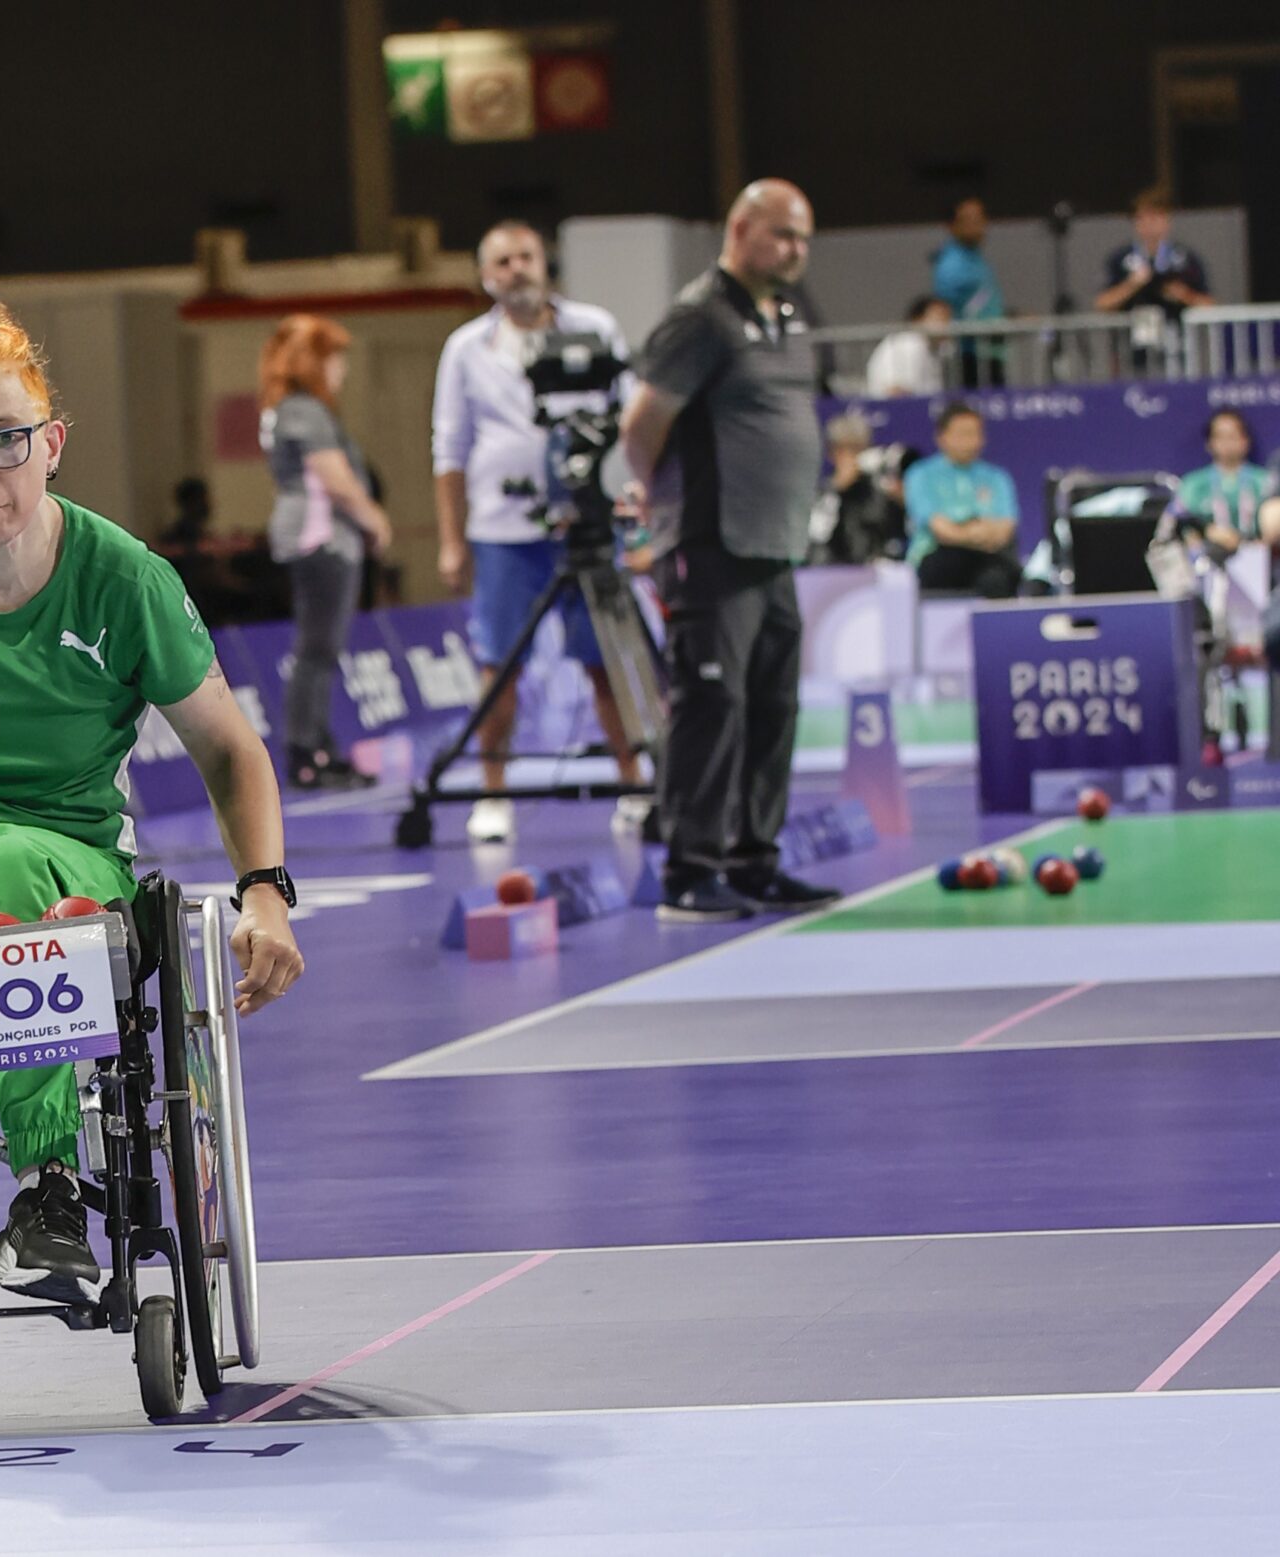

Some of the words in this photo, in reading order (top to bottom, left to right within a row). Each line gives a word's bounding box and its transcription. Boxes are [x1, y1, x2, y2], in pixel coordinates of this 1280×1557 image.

[1009, 656, 1139, 699] PARIS
[855, 702, 886, 748] 3
[1012, 696, 1142, 740] 2024
[69, 1020, 98, 1034] POR
[34, 1045, 80, 1063] 2024
